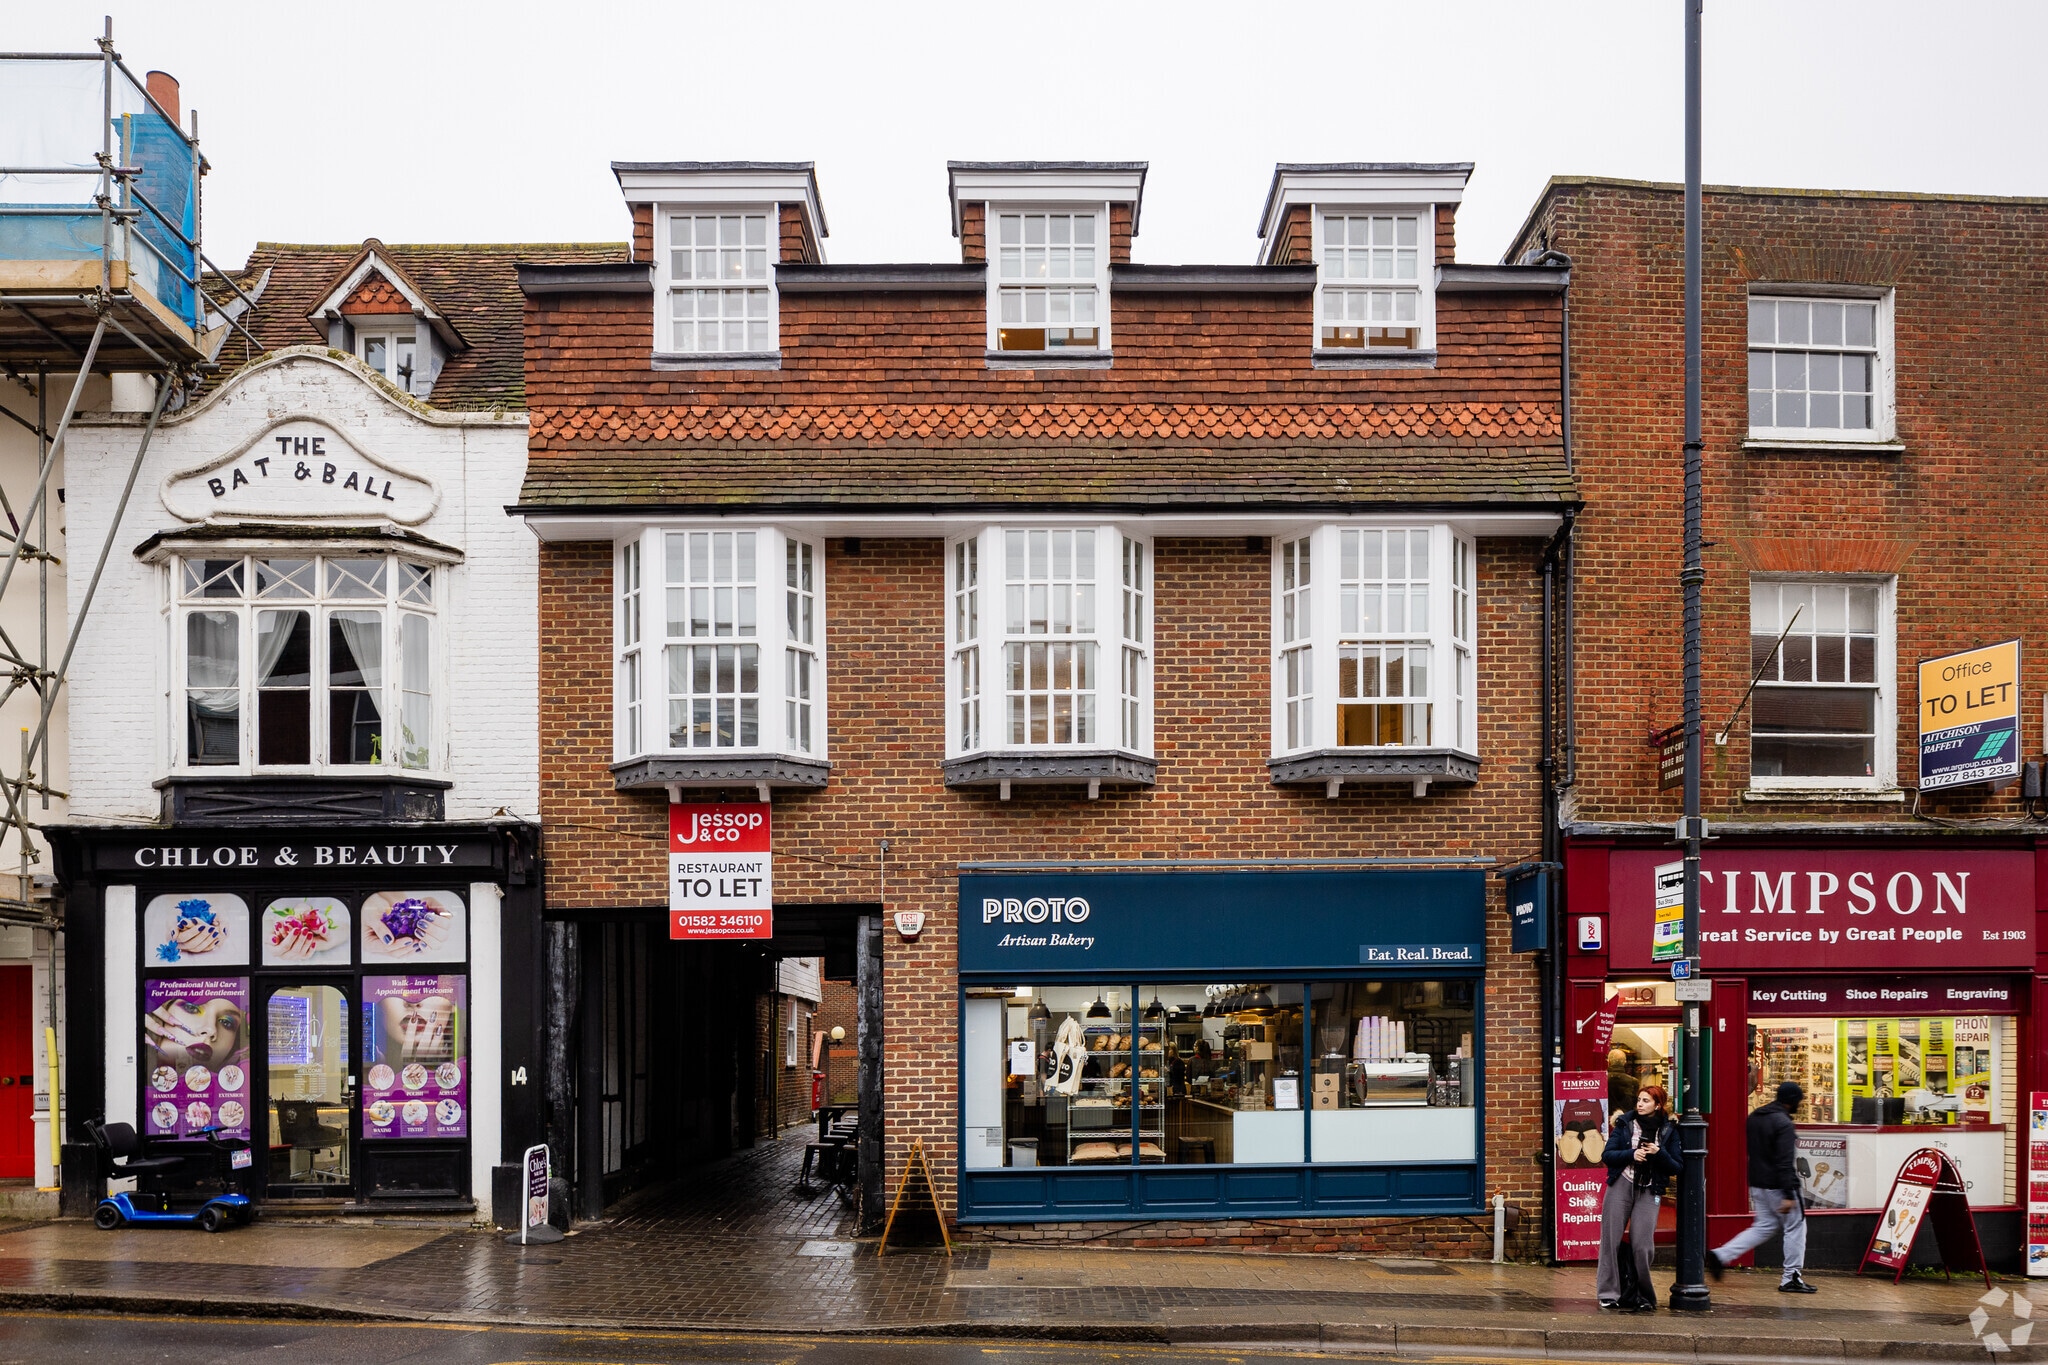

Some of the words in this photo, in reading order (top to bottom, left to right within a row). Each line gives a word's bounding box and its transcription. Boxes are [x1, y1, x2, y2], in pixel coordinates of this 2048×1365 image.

[276, 436, 326, 456] THE
[207, 457, 270, 498] BAT
[294, 461, 312, 481] &
[322, 462, 395, 501] BALL
[1942, 661, 1992, 682] Office
[1926, 694, 1957, 717] TO
[1967, 682, 2012, 709] LET
[1923, 725, 1982, 744] AITCHISON
[1674, 742, 1684, 752] CUT
[1923, 739, 1965, 755] RAFFETY
[1662, 758, 1674, 769] SHOE
[1931, 756, 2003, 774] www.argroup.co.uk
[1664, 767, 1684, 780] ENGRAV
[1924, 774, 1958, 787] 01727
[1962, 769, 1985, 782] 843
[1989, 764, 2013, 776] 232
[677, 813, 763, 844] Jessop
[134, 847, 258, 867] CHLOE
[274, 846, 299, 866] &
[313, 845, 459, 865] BEAUTY
[678, 863, 763, 874] RESTAURANT
[678, 879, 712, 898] TO
[720, 878, 763, 898] LET
[982, 897, 1091, 924] PROTO
[678, 916, 716, 926] 01582
[720, 915, 763, 926] 346110
[902, 914, 918, 923] ASH
[687, 927, 755, 935] www.jessopco.co.uk
[1699, 928, 1738, 942] reat
[1744, 928, 1812, 942] Service
[1819, 928, 1839, 944] by
[1846, 928, 1896, 941] Great
[1902, 928, 1962, 943] People
[1982, 930, 2000, 940] Est
[2002, 930, 2026, 940] 1903
[997, 934, 1046, 946] Artisan
[1049, 934, 1095, 950] Bakery
[1368, 948, 1394, 960] Eat.
[1397, 948, 1429, 960] Real.
[1432, 947, 1472, 960] Bread.
[375, 988, 420, 996] Appointment
[1753, 990, 1778, 1002] Key
[1780, 990, 1827, 1002] Cutting
[1846, 989, 1878, 999] Shoe
[1880, 989, 1928, 1001] Repairs
[1946, 988, 2008, 1001] Engraving
[1955, 1019, 1988, 1029] PHON
[1955, 1033, 1990, 1041] REPAIR
[512, 1066, 527, 1086] 14
[530, 1157, 546, 1172] Chloe's
[1908, 1157, 1938, 1174] TIMPSON
[1563, 1181, 1602, 1192] Quality
[1902, 1188, 1907, 1197] 3
[1915, 1190, 1921, 1199] 2
[1569, 1197, 1596, 1207] Shoe
[1896, 1198, 1905, 1206] Key
[1906, 1200, 1920, 1208] Deal
[1563, 1213, 1602, 1224] Repairs
